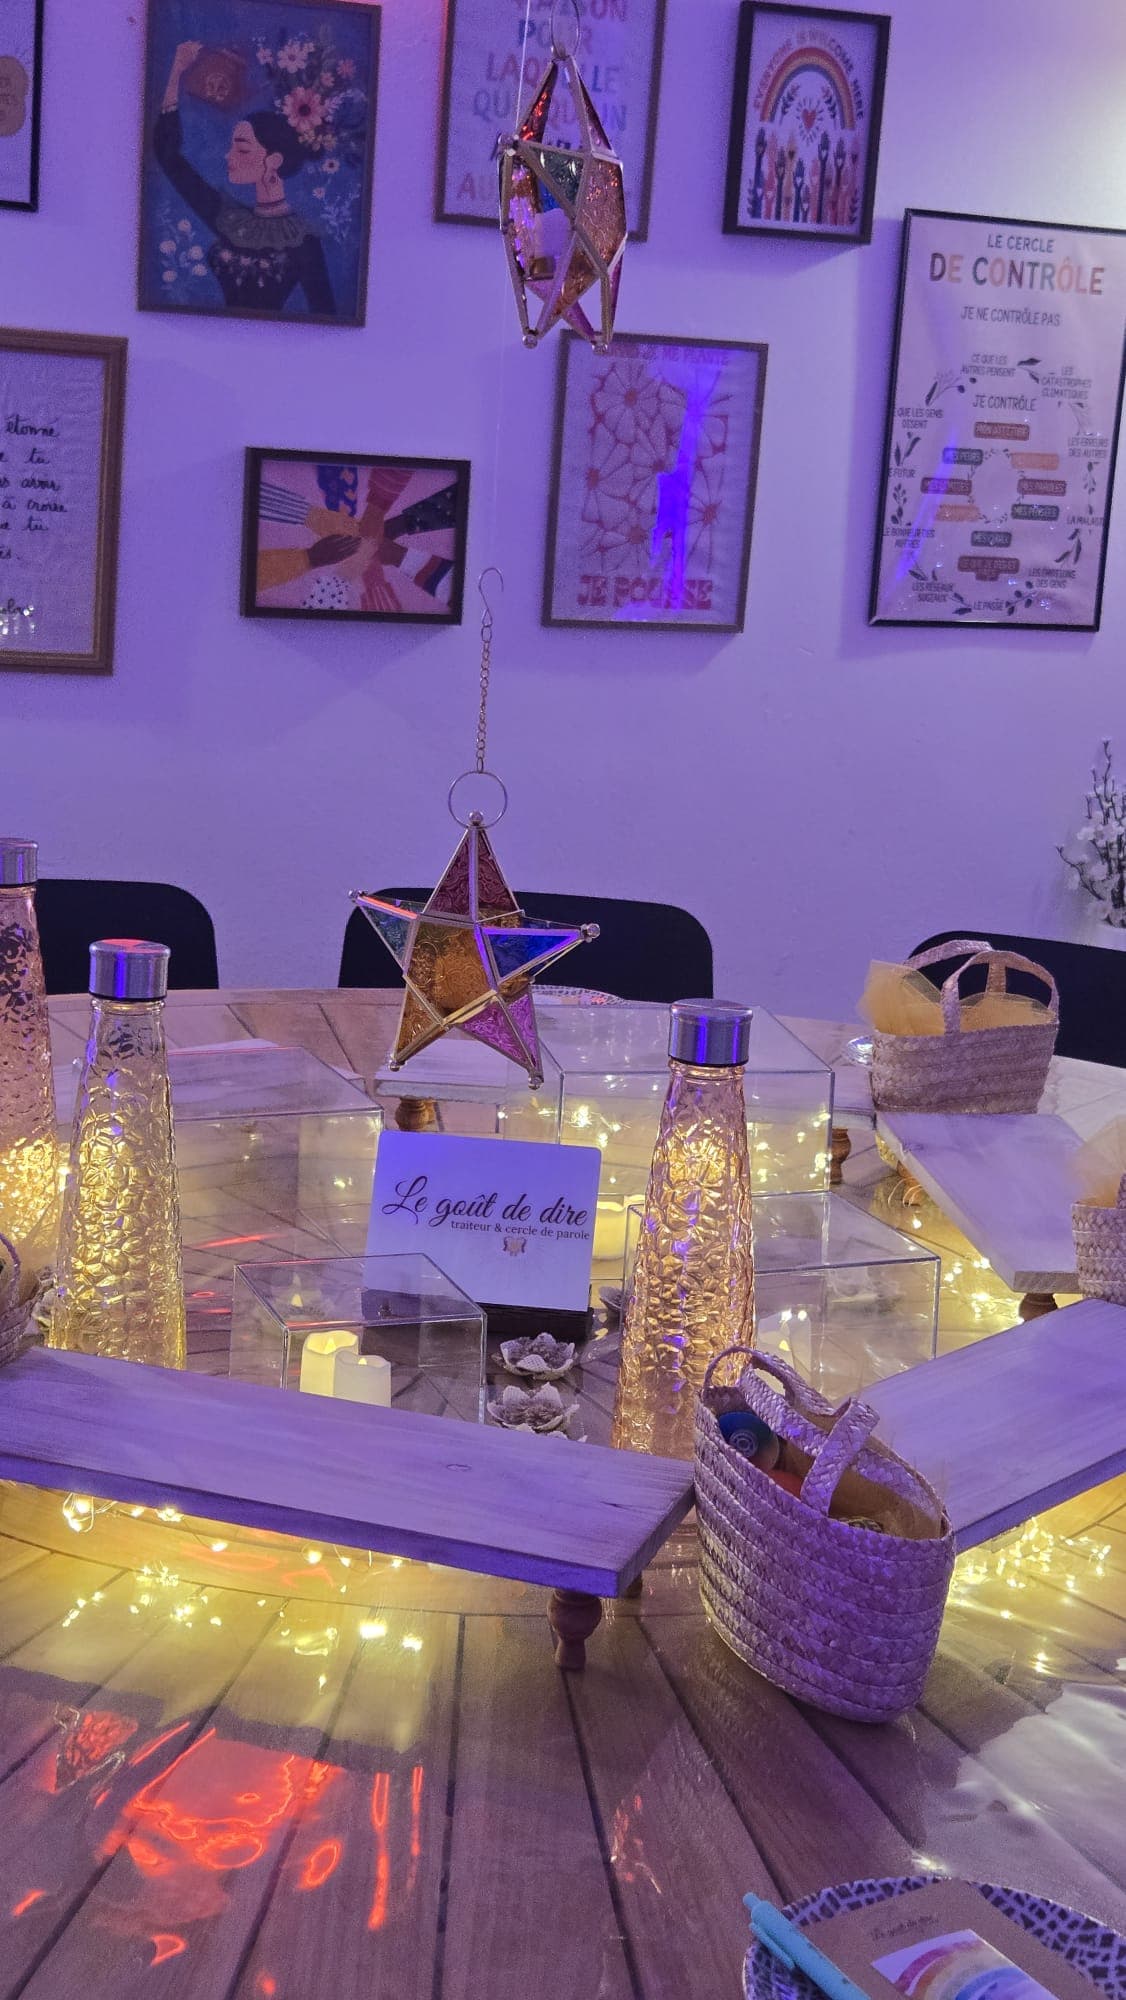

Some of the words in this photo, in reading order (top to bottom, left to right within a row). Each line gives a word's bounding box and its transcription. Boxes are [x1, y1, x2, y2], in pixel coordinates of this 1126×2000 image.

[987, 234, 1003, 249] LE
[1006, 235, 1055, 253] CERCLE
[929, 252, 964, 283] DE
[972, 255, 1105, 296] CONTRÔLE
[961, 306, 975, 321] JE
[976, 307, 989, 321] NE
[990, 307, 1041, 326] CONTRÔLE
[1041, 312, 1061, 327] PAS
[972, 394, 986, 409] JE
[987, 395, 1037, 412] CONTRÔLE
[577, 574, 608, 606] JE
[382, 1175, 428, 1225] Le
[428, 1192, 498, 1228] goût
[502, 1193, 531, 1222] de
[539, 1196, 588, 1226] dire
[450, 1220, 490, 1232] traiteur
[494, 1223, 503, 1233] &
[505, 1224, 537, 1236] cercle
[541, 1227, 554, 1237] de
[556, 1228, 590, 1241] parole
